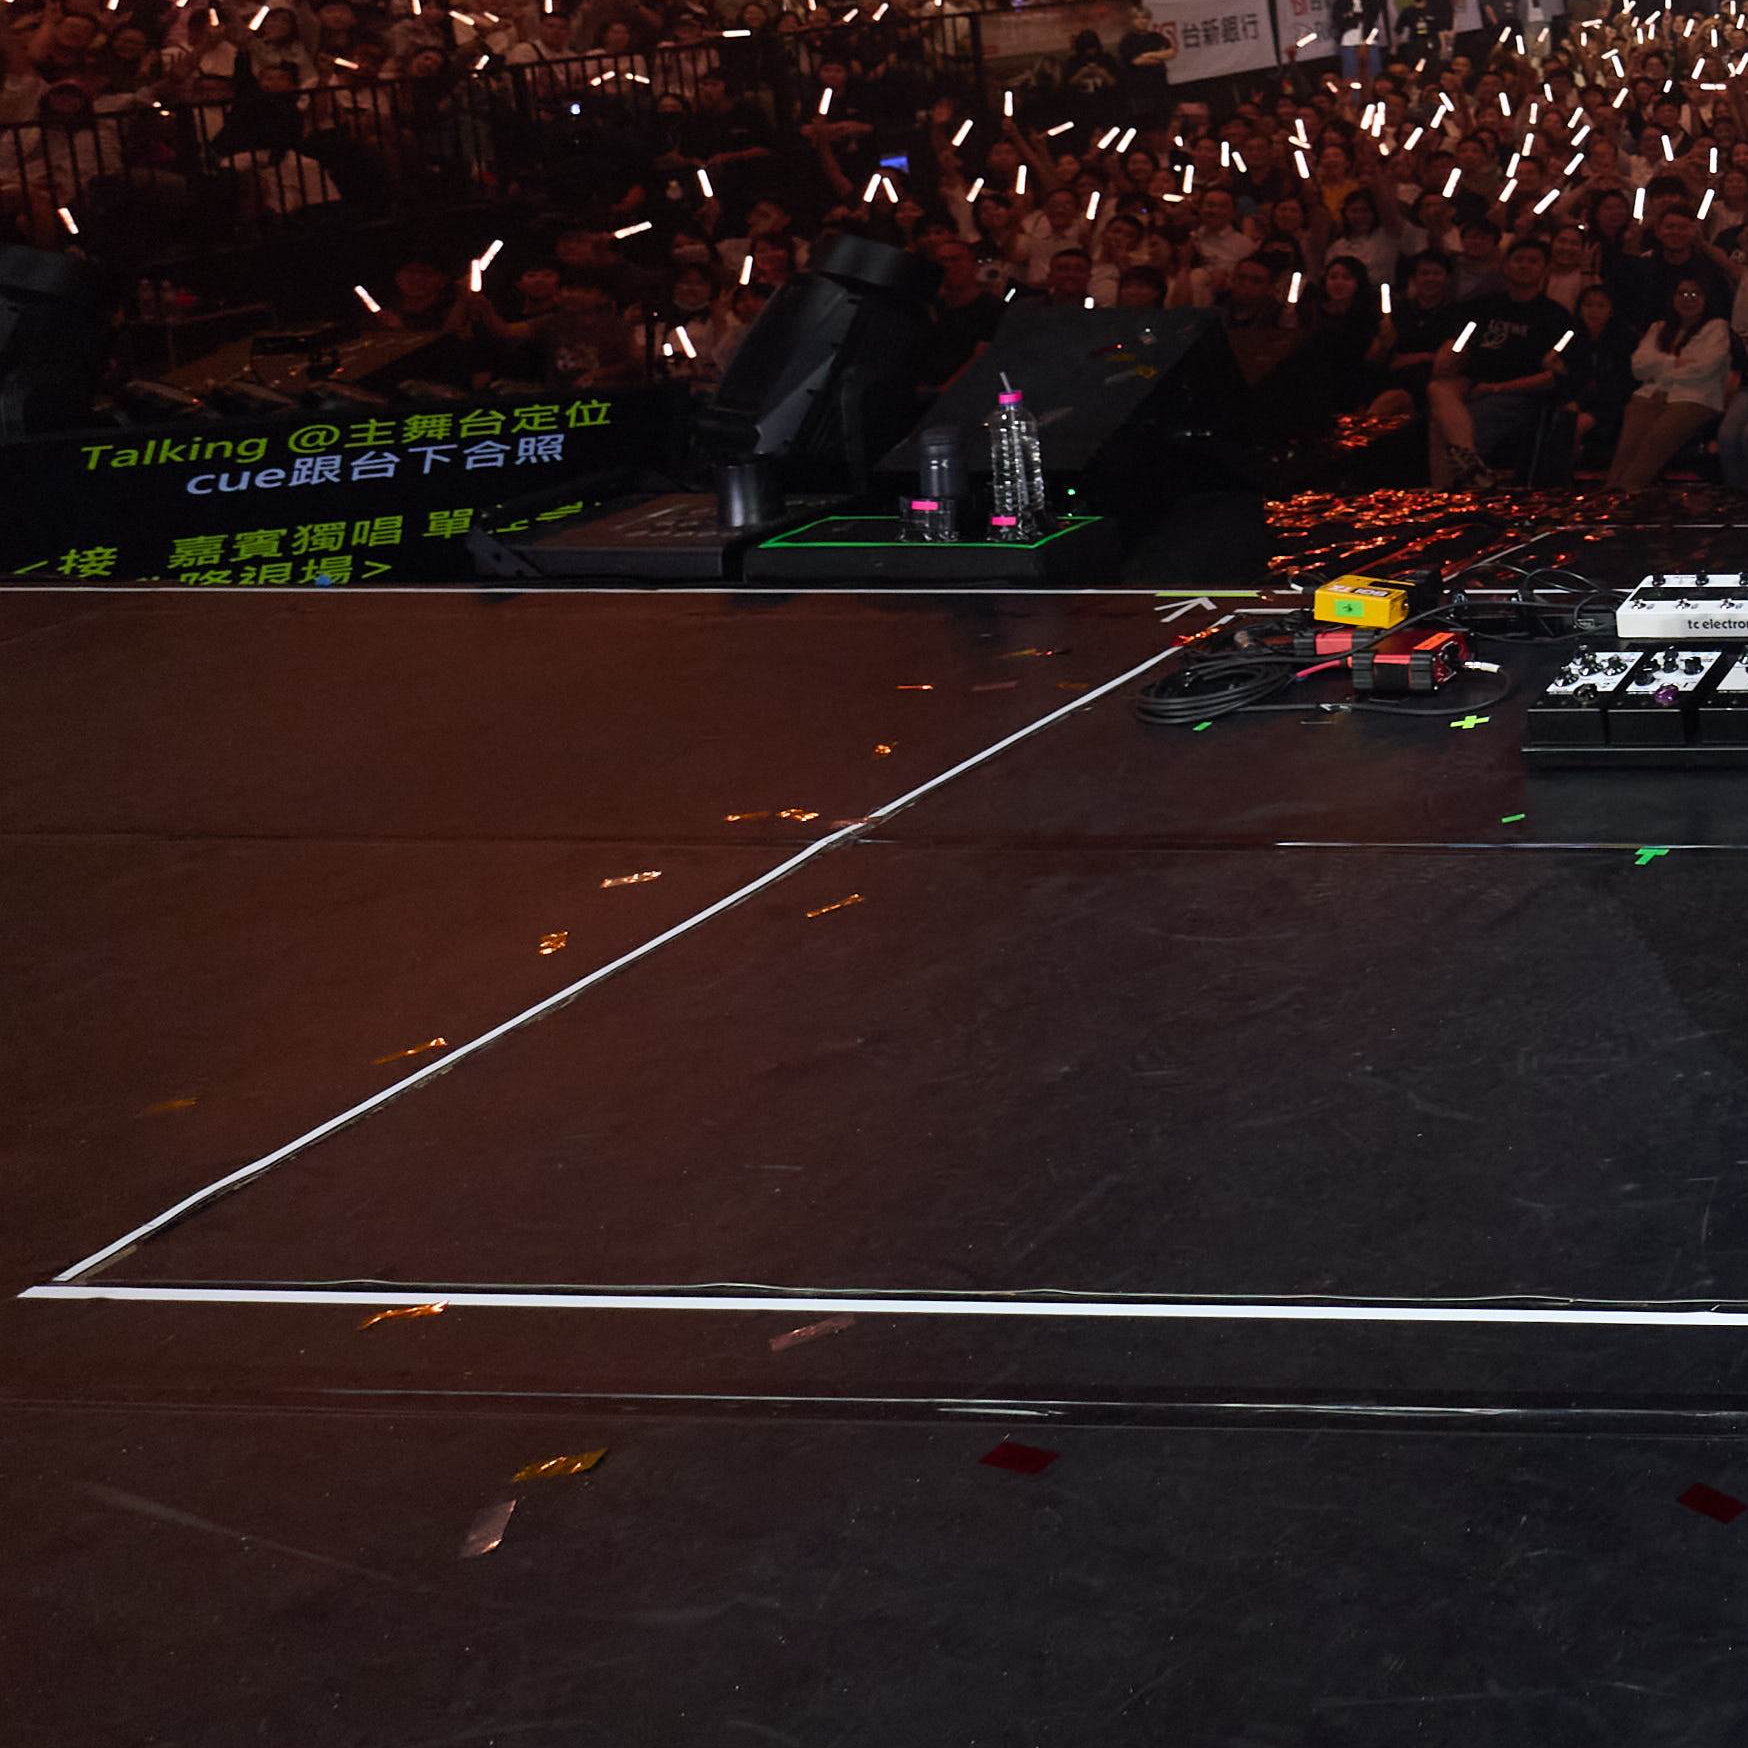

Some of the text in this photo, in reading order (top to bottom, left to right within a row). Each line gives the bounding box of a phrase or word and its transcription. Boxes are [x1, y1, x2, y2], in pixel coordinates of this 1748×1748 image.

[1182, 13, 1259, 49] 台新銀行
[80, 399, 612, 471] Talking @主舞台定位
[186, 434, 566, 495] cue跟台下合照
[168, 515, 404, 569] 嘉賓獨唱
[1687, 619, 1700, 629] tc
